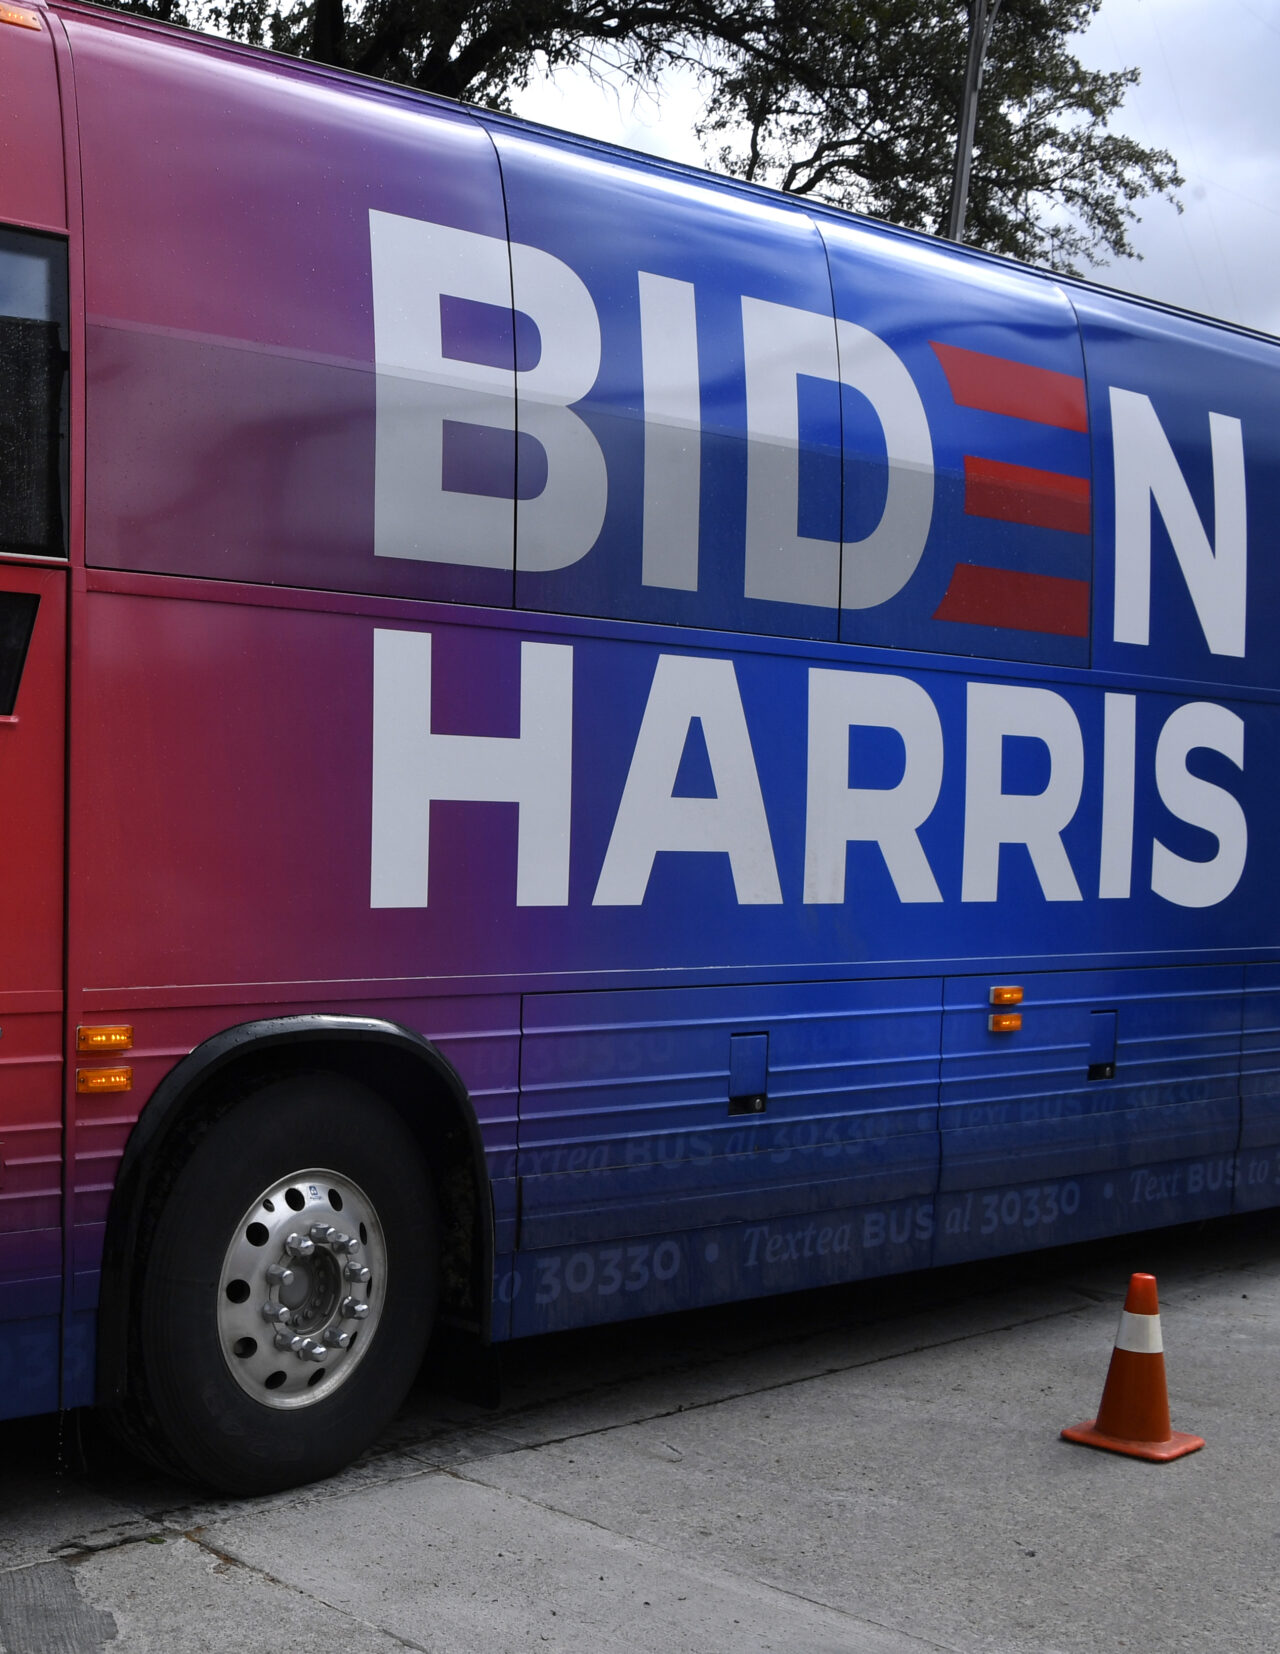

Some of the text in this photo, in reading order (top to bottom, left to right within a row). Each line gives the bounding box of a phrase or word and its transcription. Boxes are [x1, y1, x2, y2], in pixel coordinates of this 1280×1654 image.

[368, 207, 1248, 658] BIDEN
[369, 626, 1249, 909] HARRIS
[534, 1240, 682, 1306] 30330
[744, 1224, 852, 1267] Textea
[862, 1203, 934, 1249] BUS
[944, 1191, 973, 1235] al
[980, 1181, 1081, 1236] 30330
[1129, 1167, 1181, 1205] Text
[1186, 1157, 1242, 1196] BUS
[1247, 1154, 1269, 1186] to
